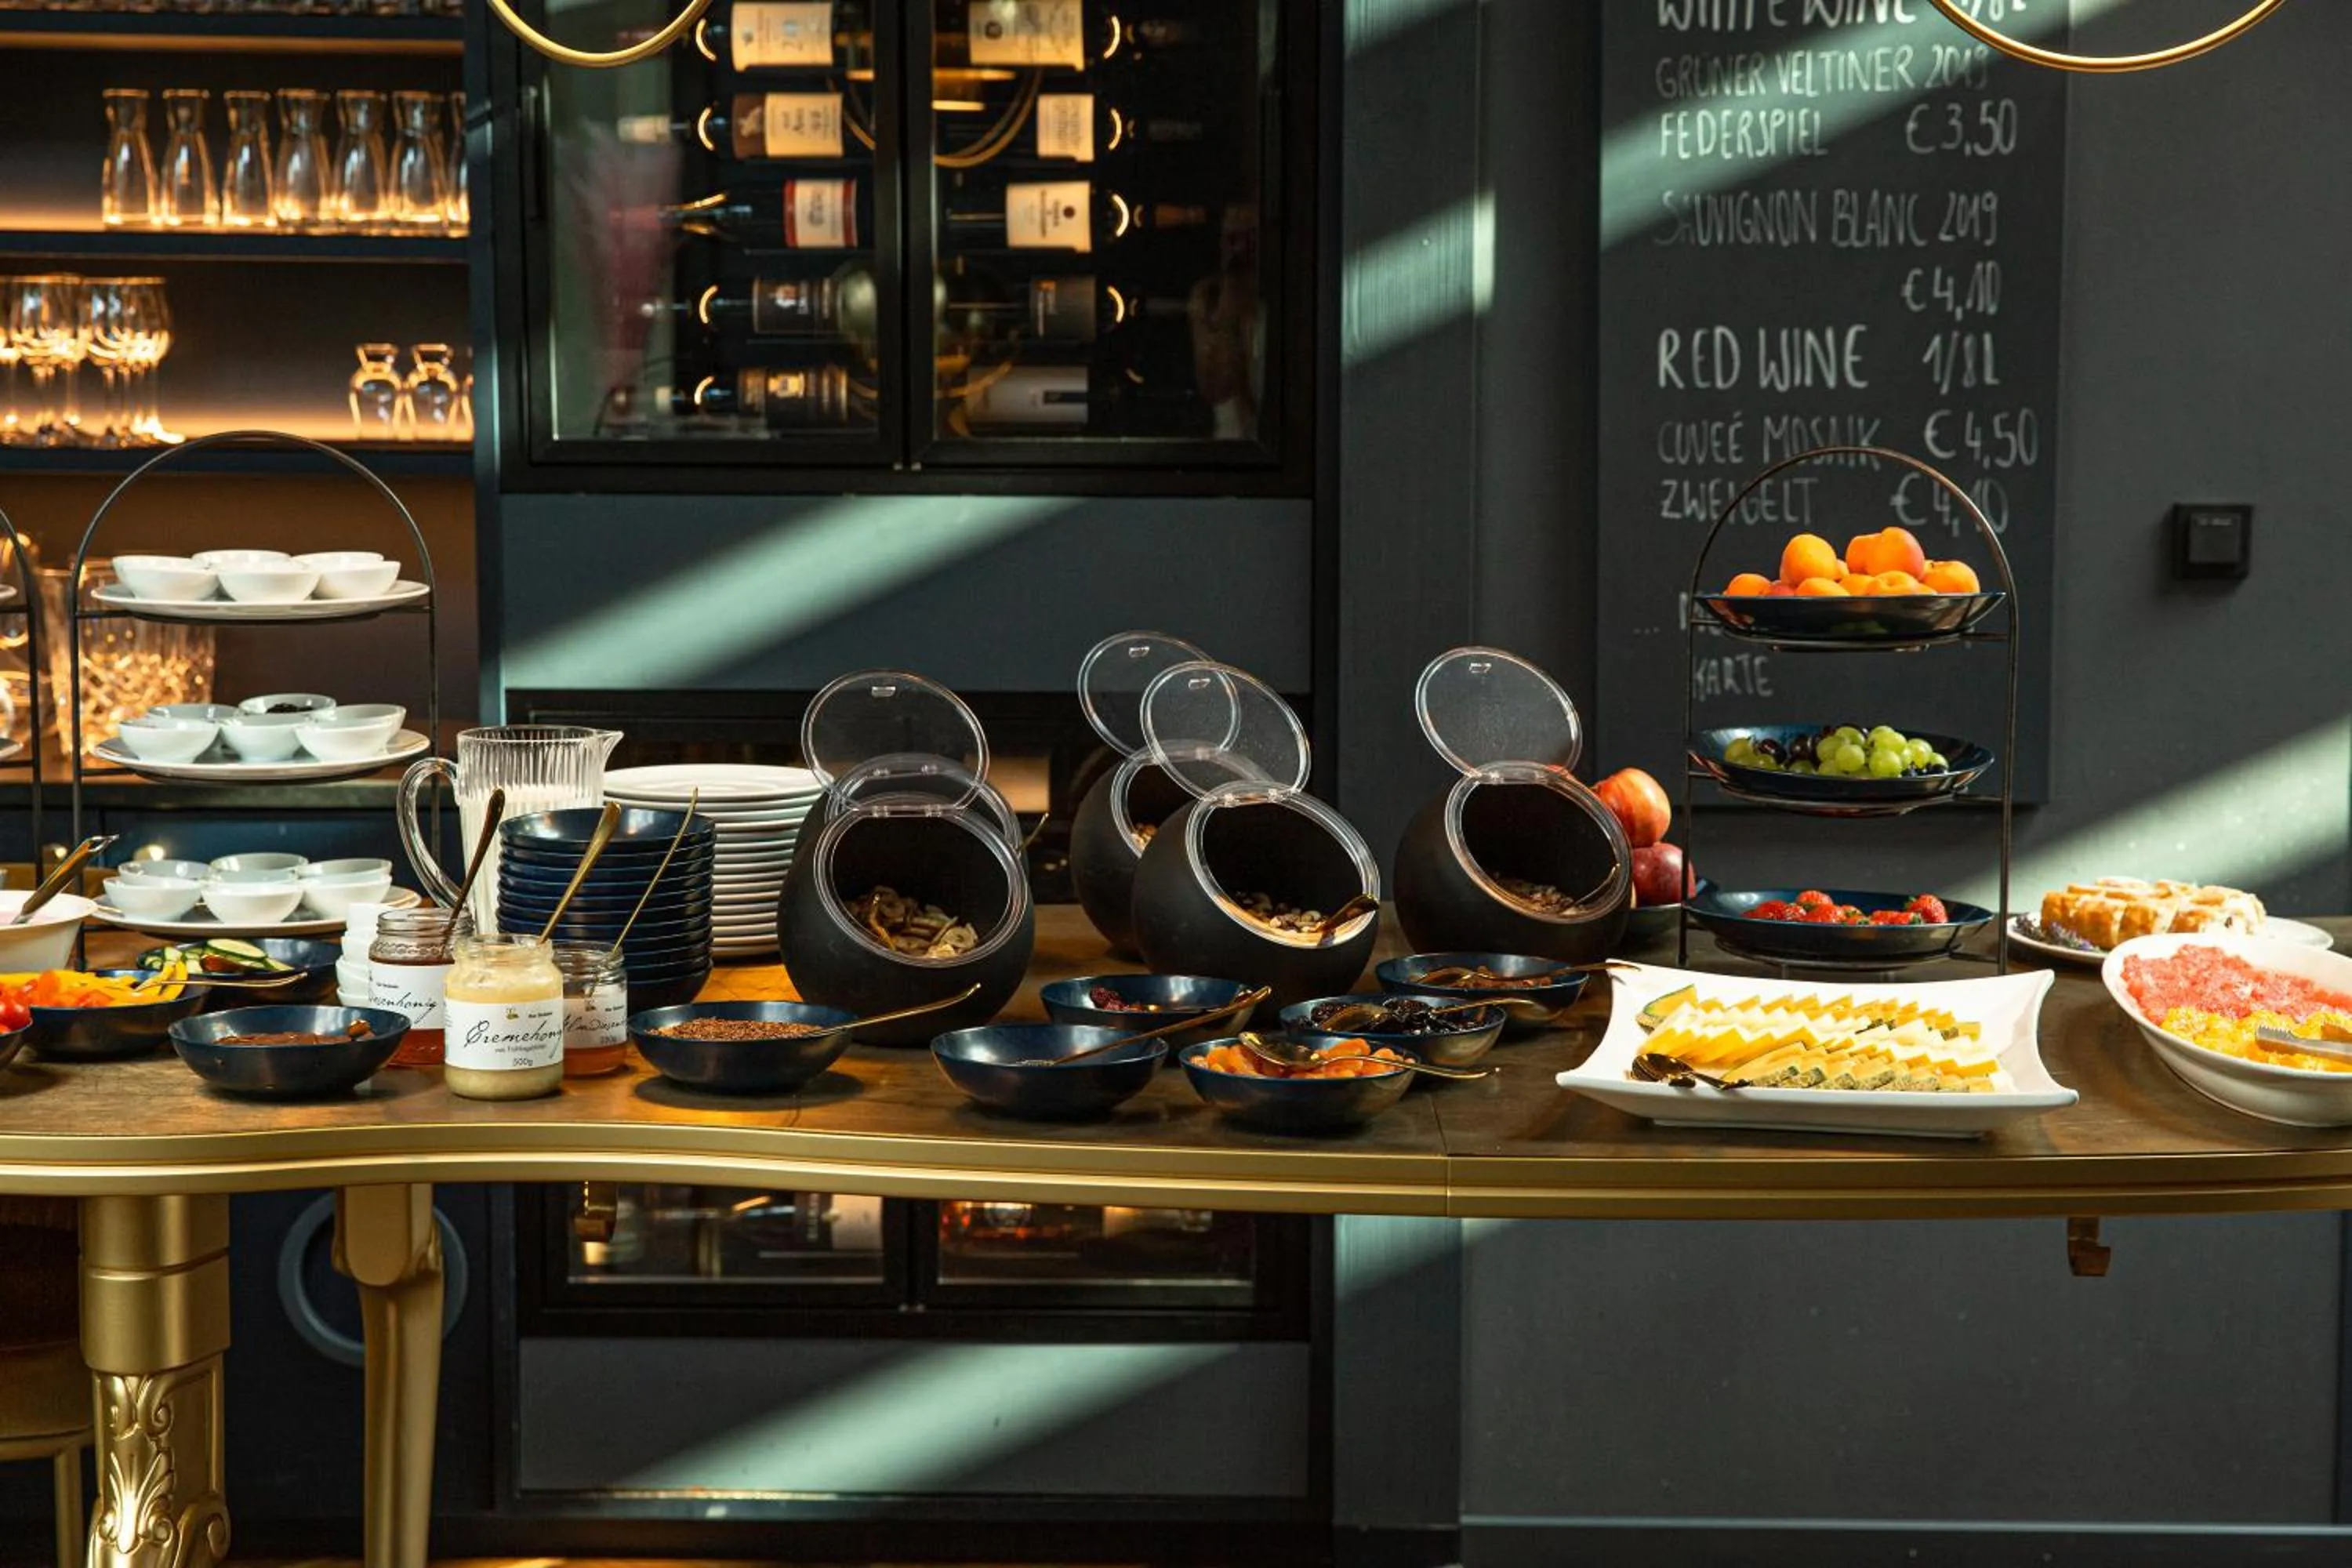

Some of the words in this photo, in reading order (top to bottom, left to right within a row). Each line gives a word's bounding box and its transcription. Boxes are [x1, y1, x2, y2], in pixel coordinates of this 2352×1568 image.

[1774, 44, 1916, 97] VELTINER
[1923, 42, 1990, 91] 2019
[1660, 108, 1829, 159] FEDERSPIEL
[1831, 188, 1929, 249] BLANC
[1938, 191, 1998, 247] 2019
[1657, 325, 1741, 390] RED
[1759, 324, 1869, 393] WINE
[1657, 410, 1744, 466] CUVEÉ
[1763, 414, 1882, 472] MOSAIK
[1661, 477, 1820, 526] ZWEIGELT
